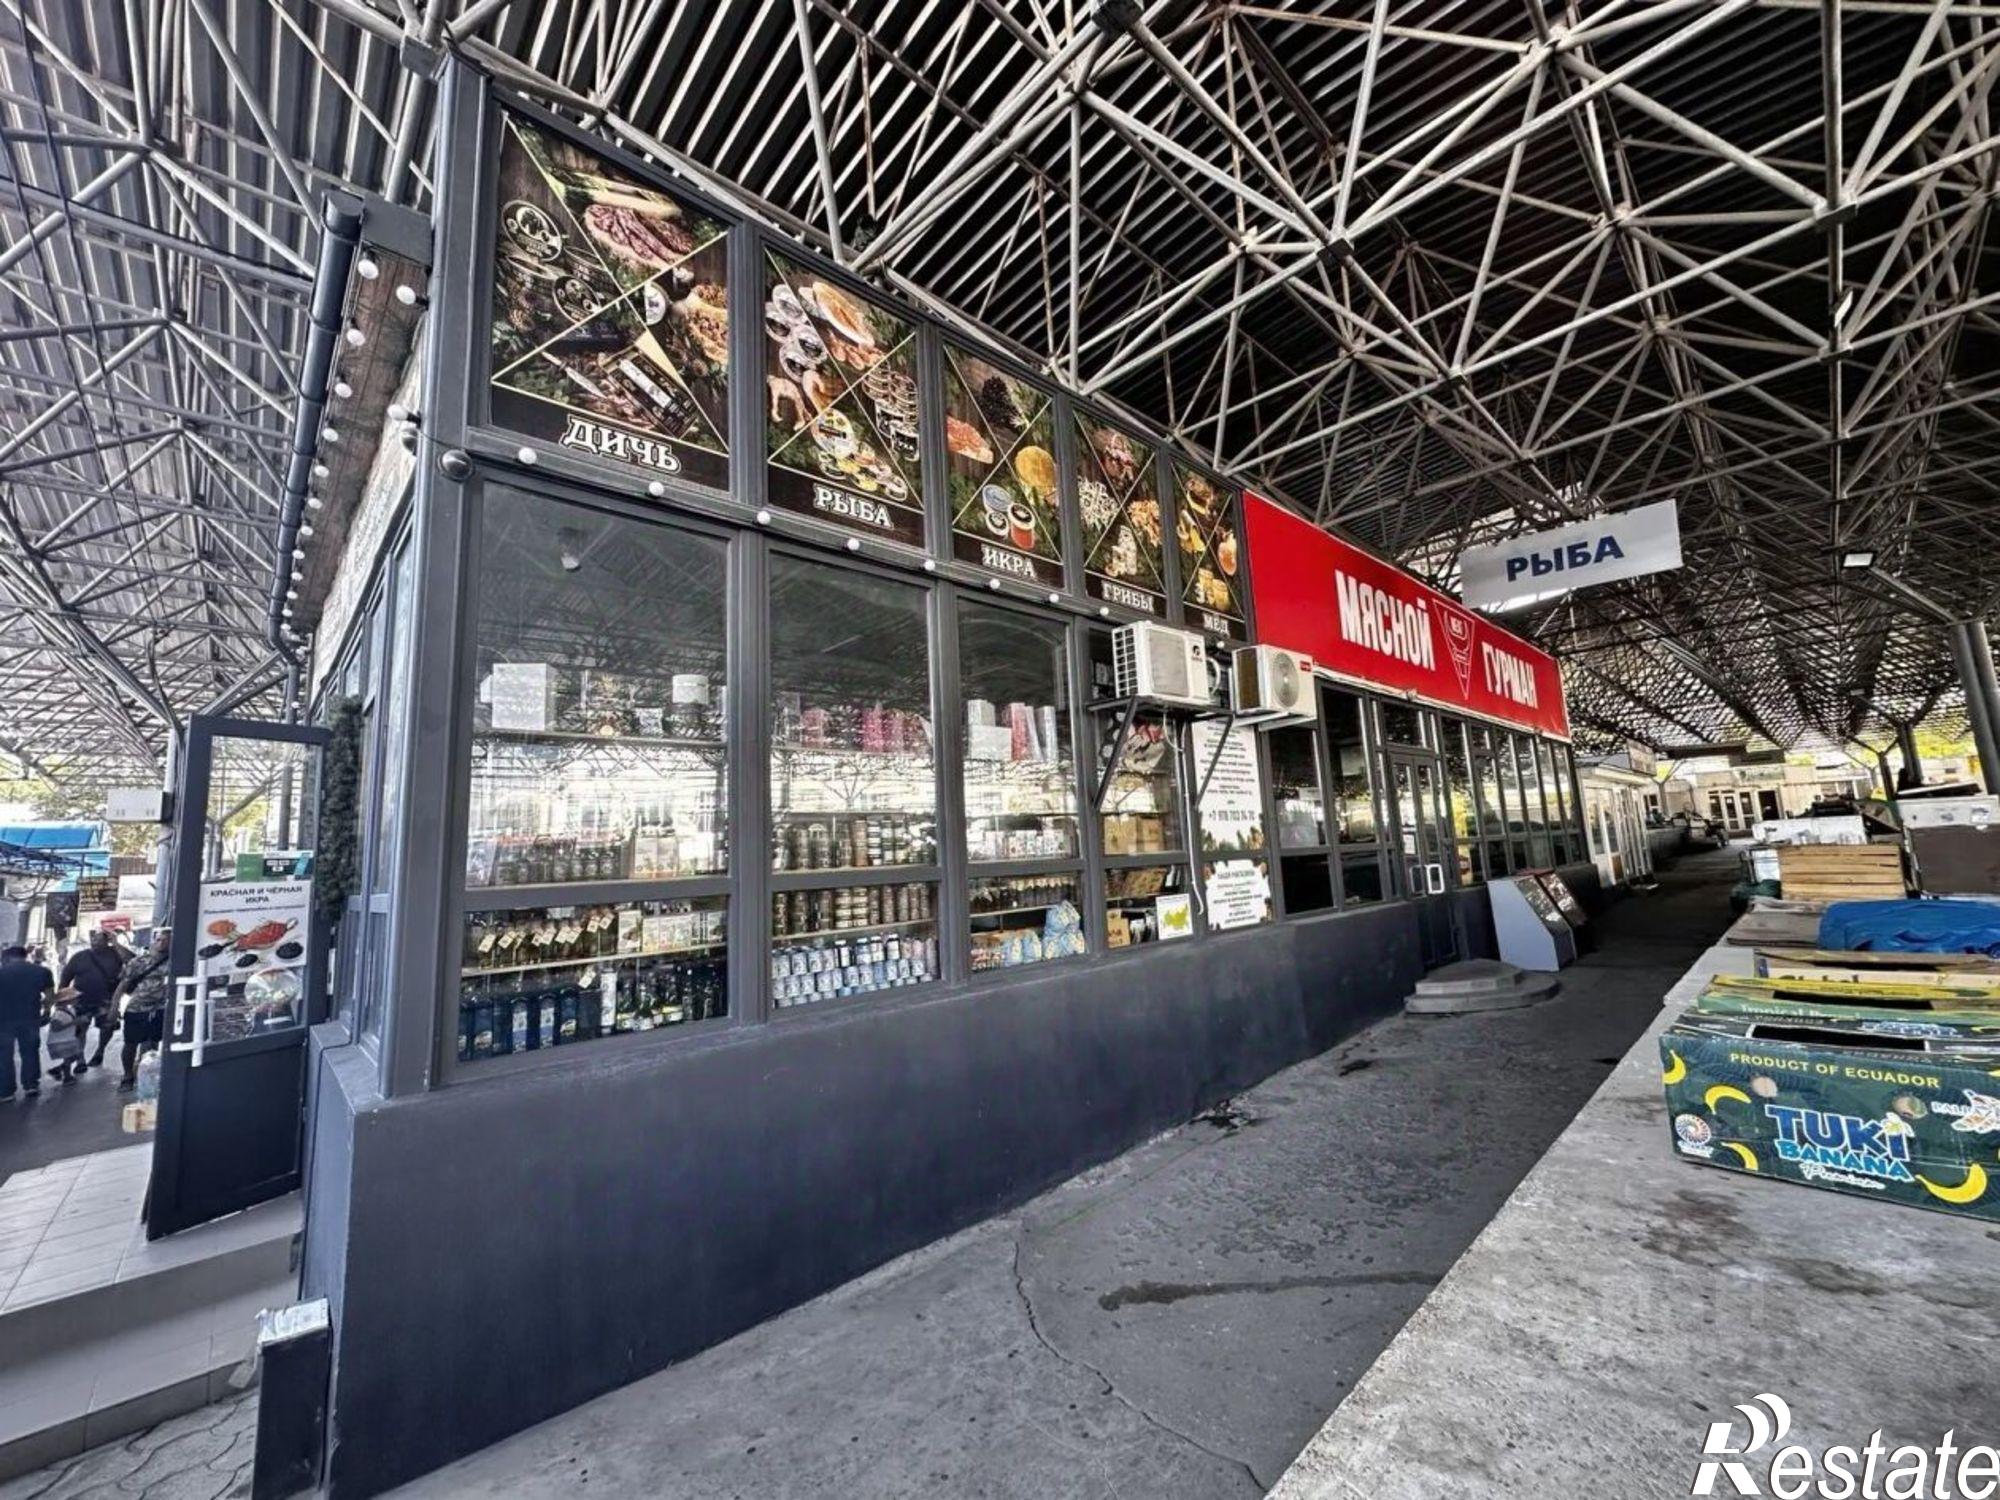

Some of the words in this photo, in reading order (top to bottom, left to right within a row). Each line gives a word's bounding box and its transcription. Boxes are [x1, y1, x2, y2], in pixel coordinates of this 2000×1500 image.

[561, 415, 681, 473] ДИЧЬ
[814, 484, 893, 529] РЫБА
[982, 545, 1036, 580] ИКРА
[1507, 535, 1624, 582] РЫБА
[1101, 581, 1154, 612] ГРИБЫ
[1335, 569, 1435, 671] МЯСНОЙ
[1482, 642, 1538, 709] ГУРМАН
[211, 887, 255, 898] КРАСНАЯ
[257, 887, 265, 895] И
[246, 895, 270, 905] ИКРА
[1731, 1053, 1809, 1072] PRODUCT
[1816, 1062, 1839, 1076] OF
[1846, 1067, 1941, 1088] ECUADOR
[1774, 1139, 1915, 1182] BANANA
